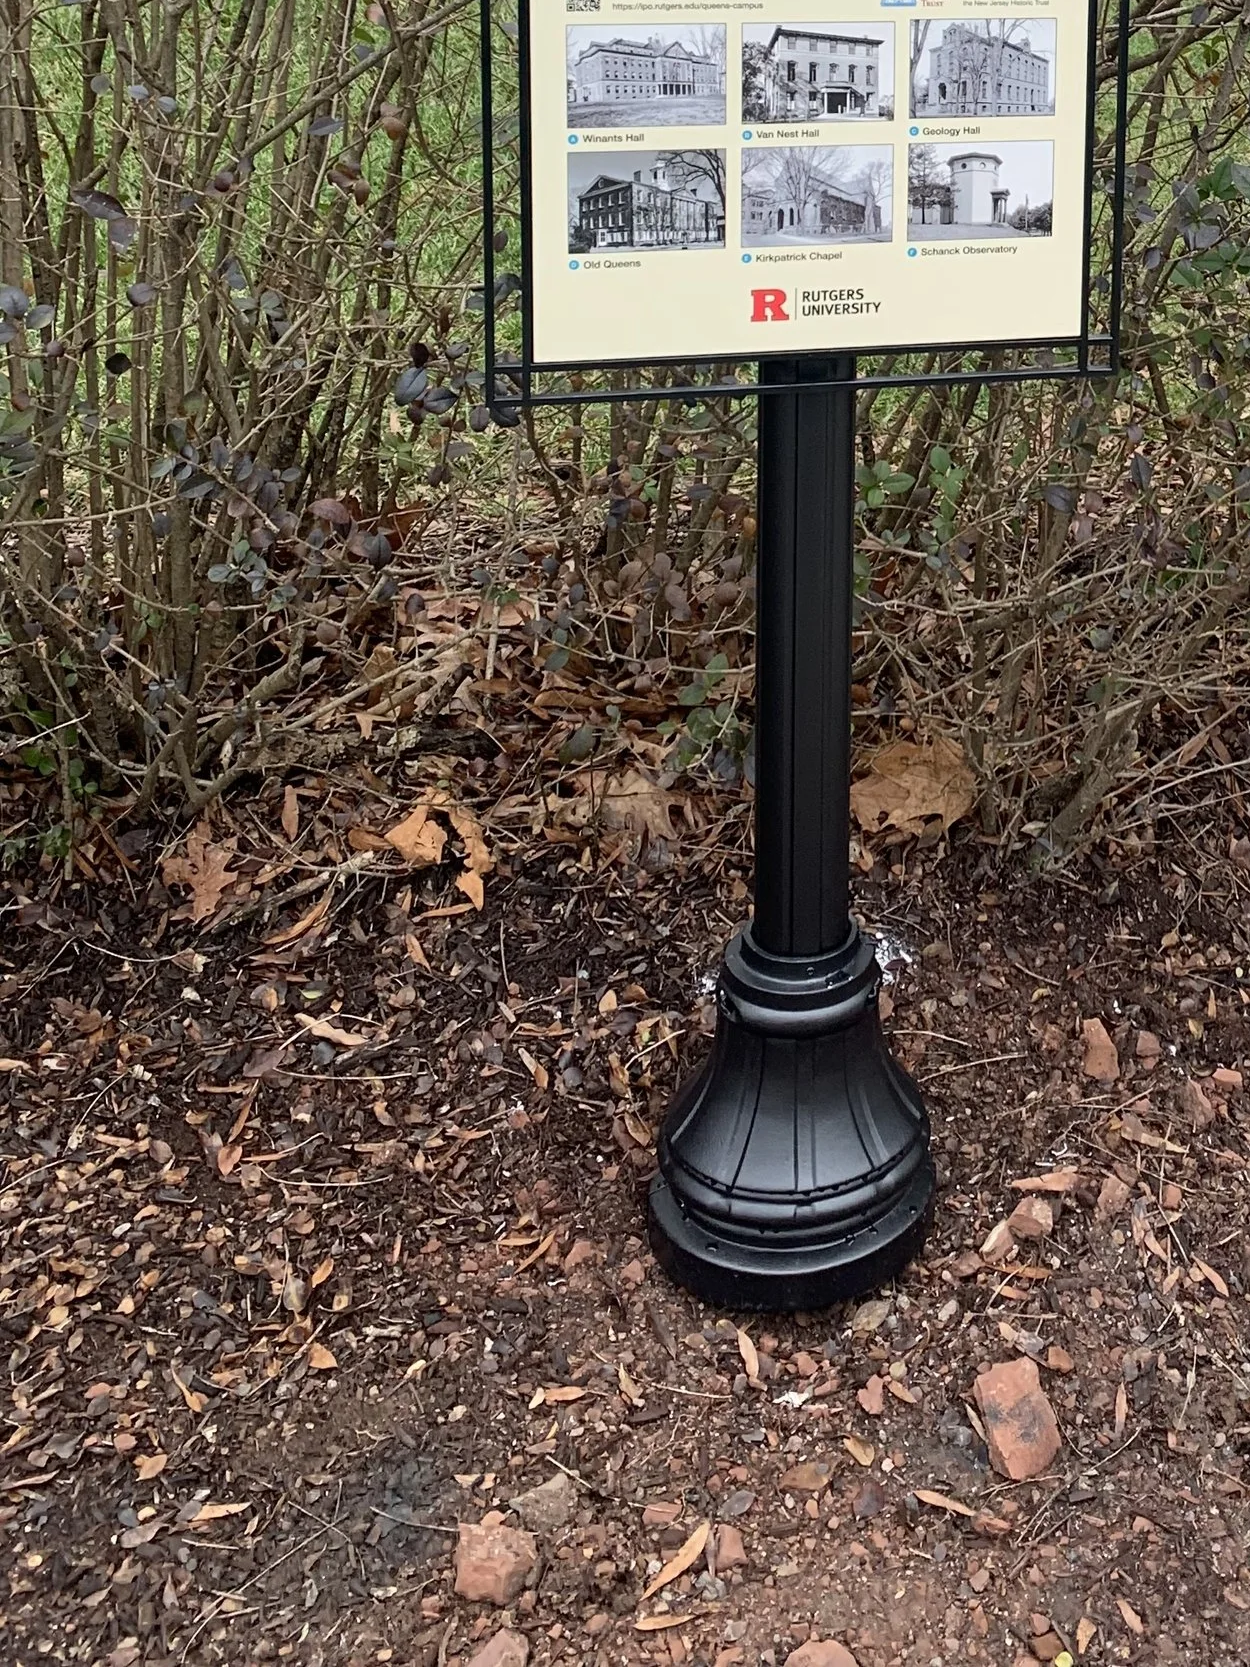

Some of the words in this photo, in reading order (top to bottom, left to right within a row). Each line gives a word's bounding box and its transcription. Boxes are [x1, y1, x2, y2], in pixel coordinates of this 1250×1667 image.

[756, 130, 774, 138] Van
[776, 129, 798, 138] Nest
[801, 128, 819, 137] Hall
[922, 126, 960, 137] Geology
[963, 126, 980, 134] Hall
[582, 133, 623, 143] Winants
[625, 133, 644, 142] Hall
[920, 246, 960, 256] Schanck
[962, 244, 1018, 256] Observatory
[755, 252, 807, 263] Kirkpatrick
[808, 250, 842, 261] Chapel
[583, 259, 601, 269] Old
[603, 258, 641, 269] Queens
[802, 288, 864, 303] RUTGERS
[750, 288, 790, 323] R
[802, 301, 882, 317] UNIVERSITY
